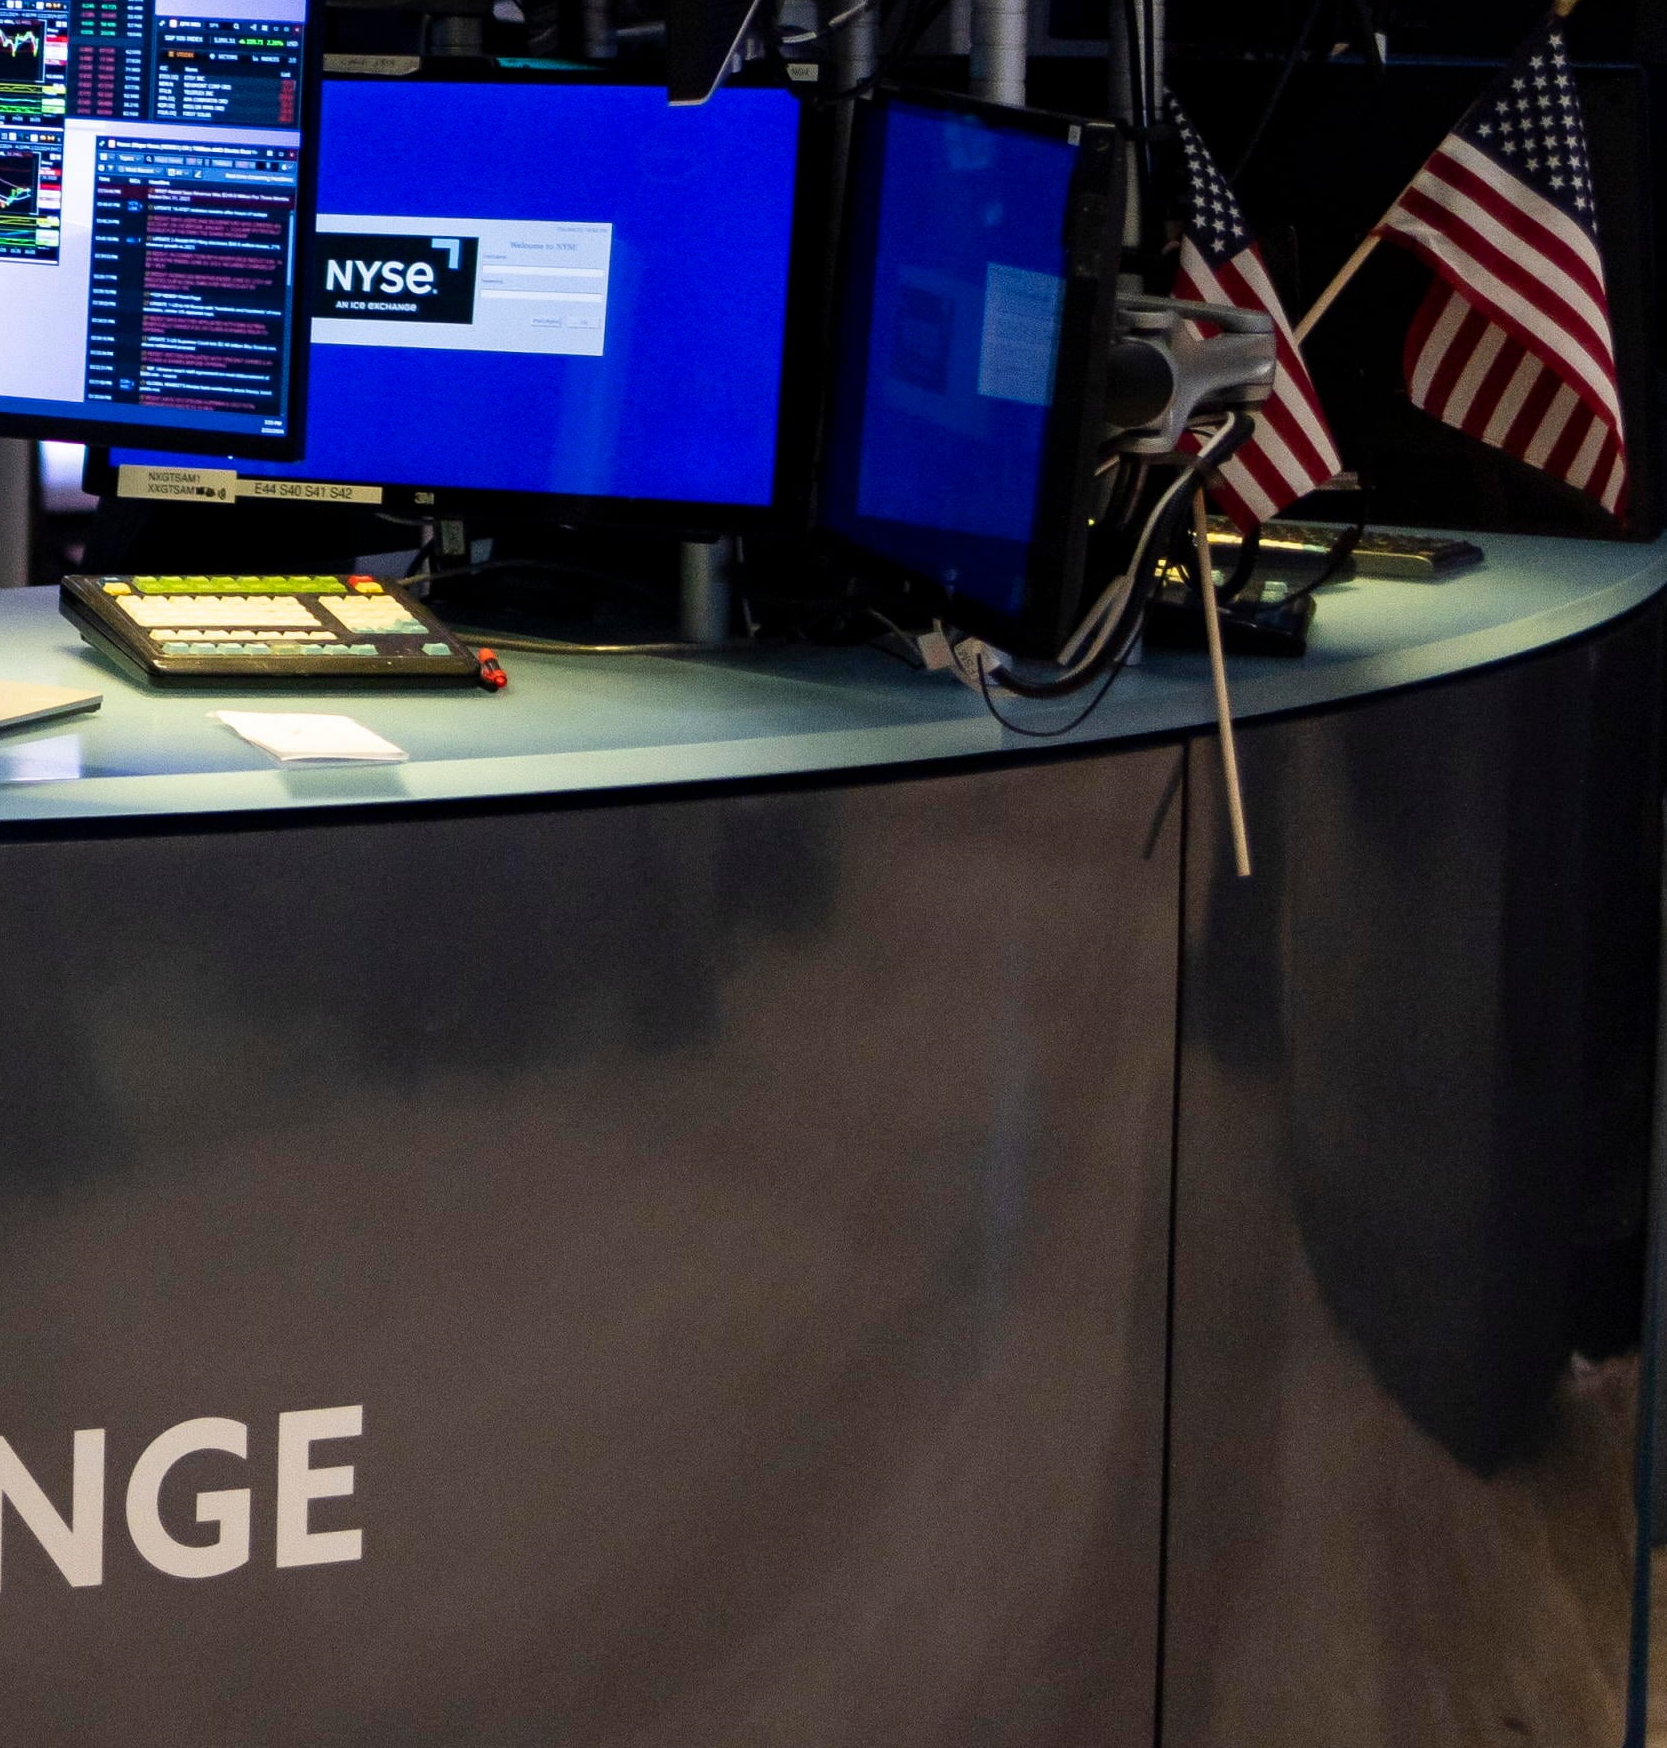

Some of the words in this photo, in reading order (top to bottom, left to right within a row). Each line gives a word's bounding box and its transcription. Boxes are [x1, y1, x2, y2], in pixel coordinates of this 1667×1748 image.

[254, 483, 276, 495] E44
[279, 485, 301, 496] S40
[305, 486, 327, 498] S41
[330, 488, 352, 500] S42
